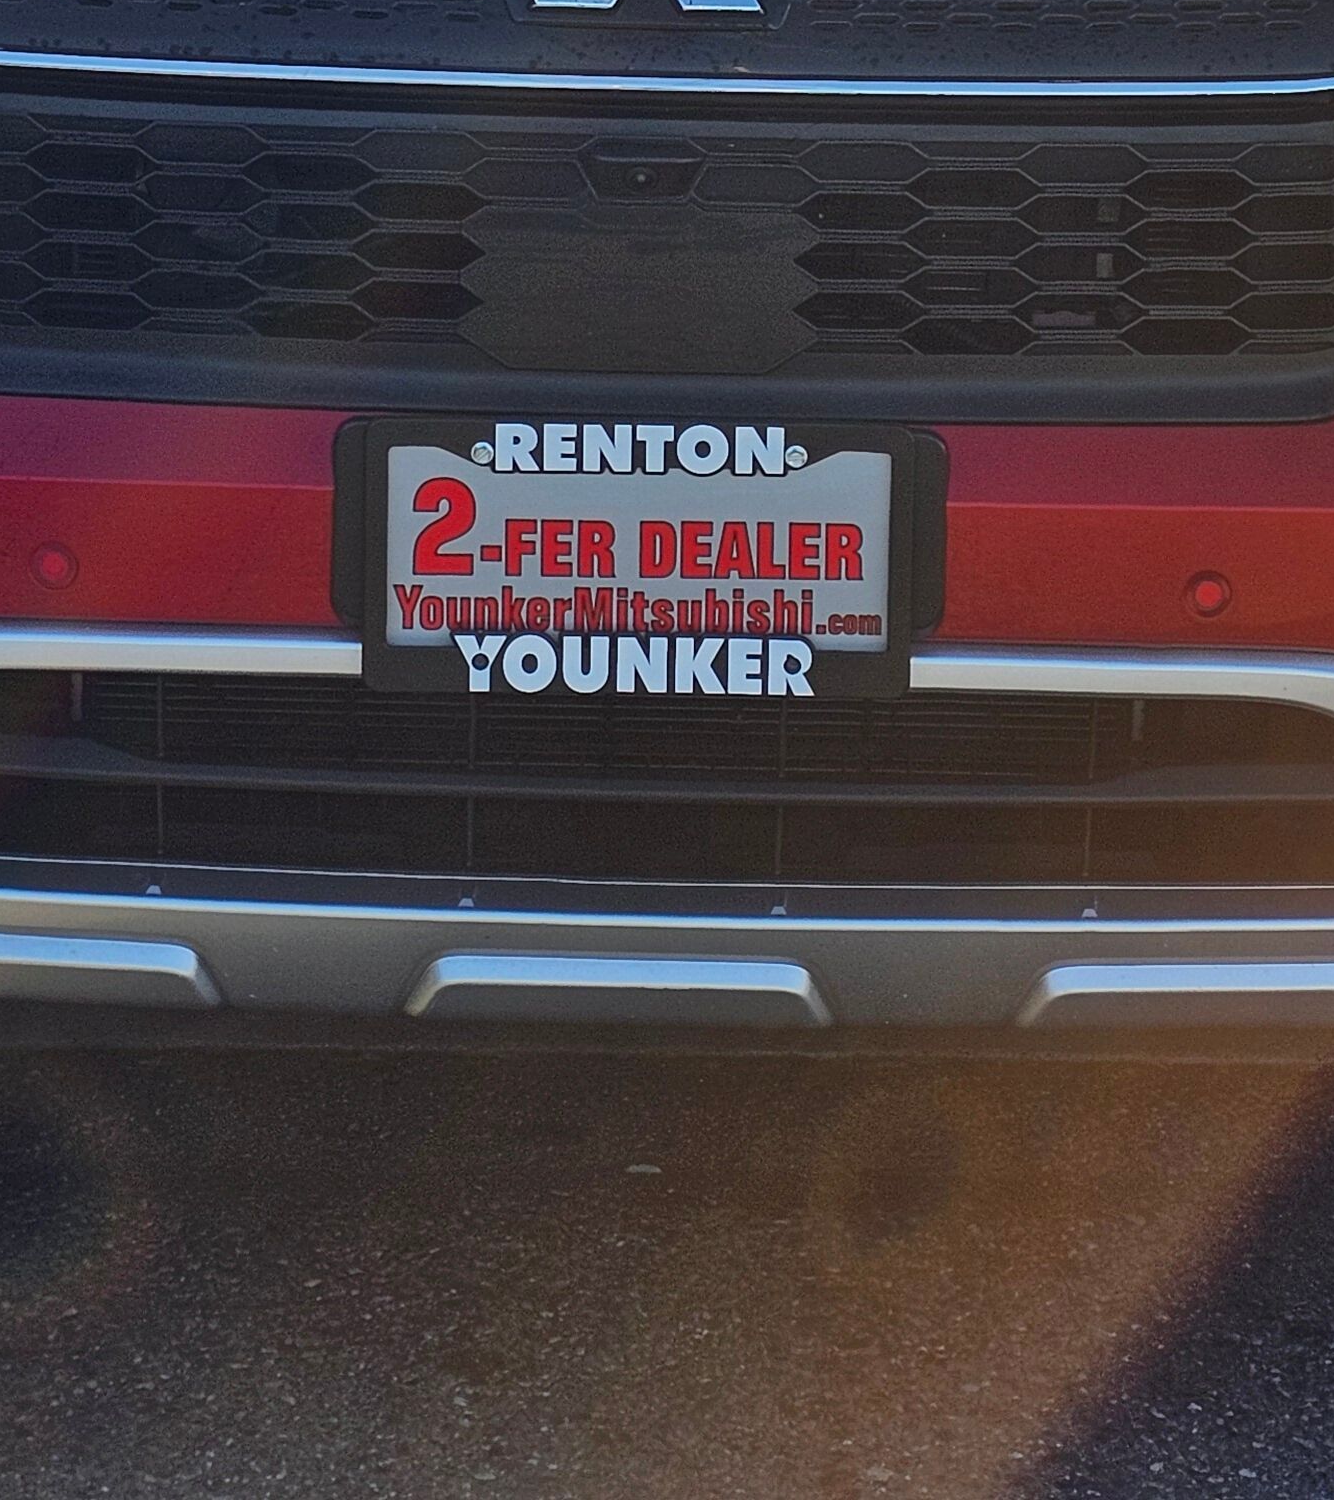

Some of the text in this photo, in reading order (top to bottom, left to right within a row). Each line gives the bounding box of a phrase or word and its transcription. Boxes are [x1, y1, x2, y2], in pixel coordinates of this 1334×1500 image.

[494, 423, 786, 475] RENTON
[412, 477, 865, 581] 2-FER DEALER
[394, 583, 883, 636] YounkerMitsubishi.com
[453, 633, 815, 697] YOUNKER
